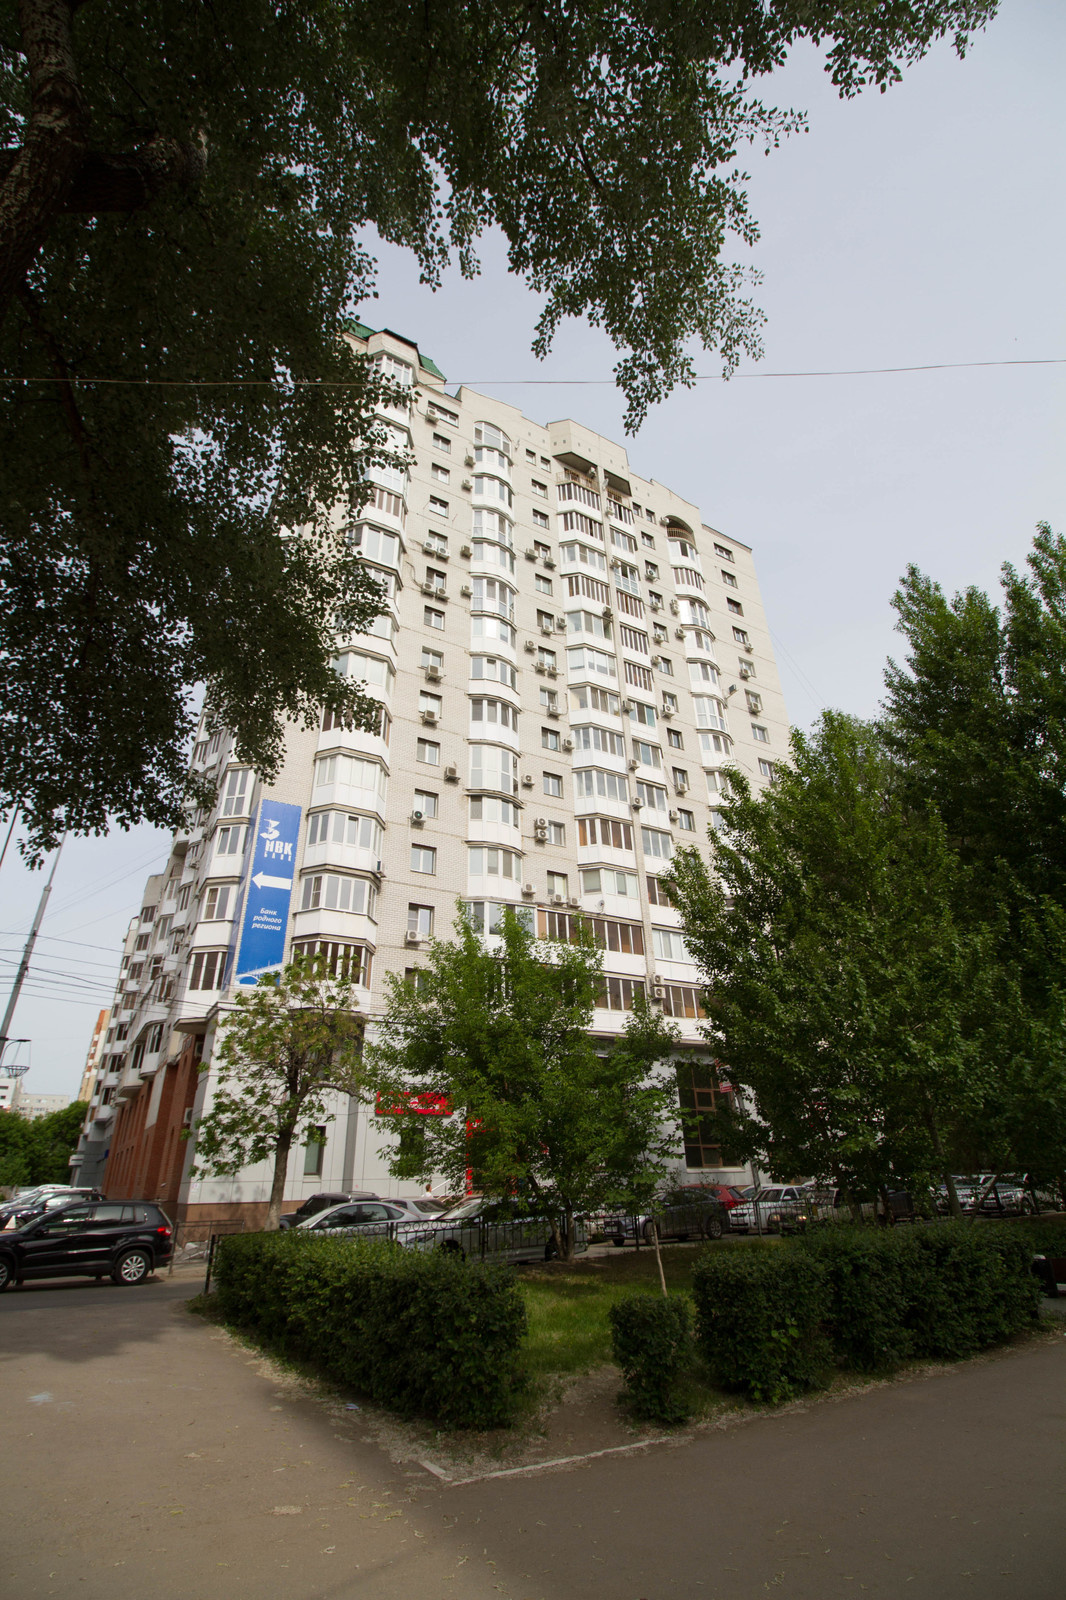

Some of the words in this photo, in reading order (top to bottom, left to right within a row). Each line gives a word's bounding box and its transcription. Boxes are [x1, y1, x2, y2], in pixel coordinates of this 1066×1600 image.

[265, 840, 293, 856] НВК
[260, 907, 278, 916] Банк
[252, 915, 283, 924] родного
[251, 922, 282, 931] региона
